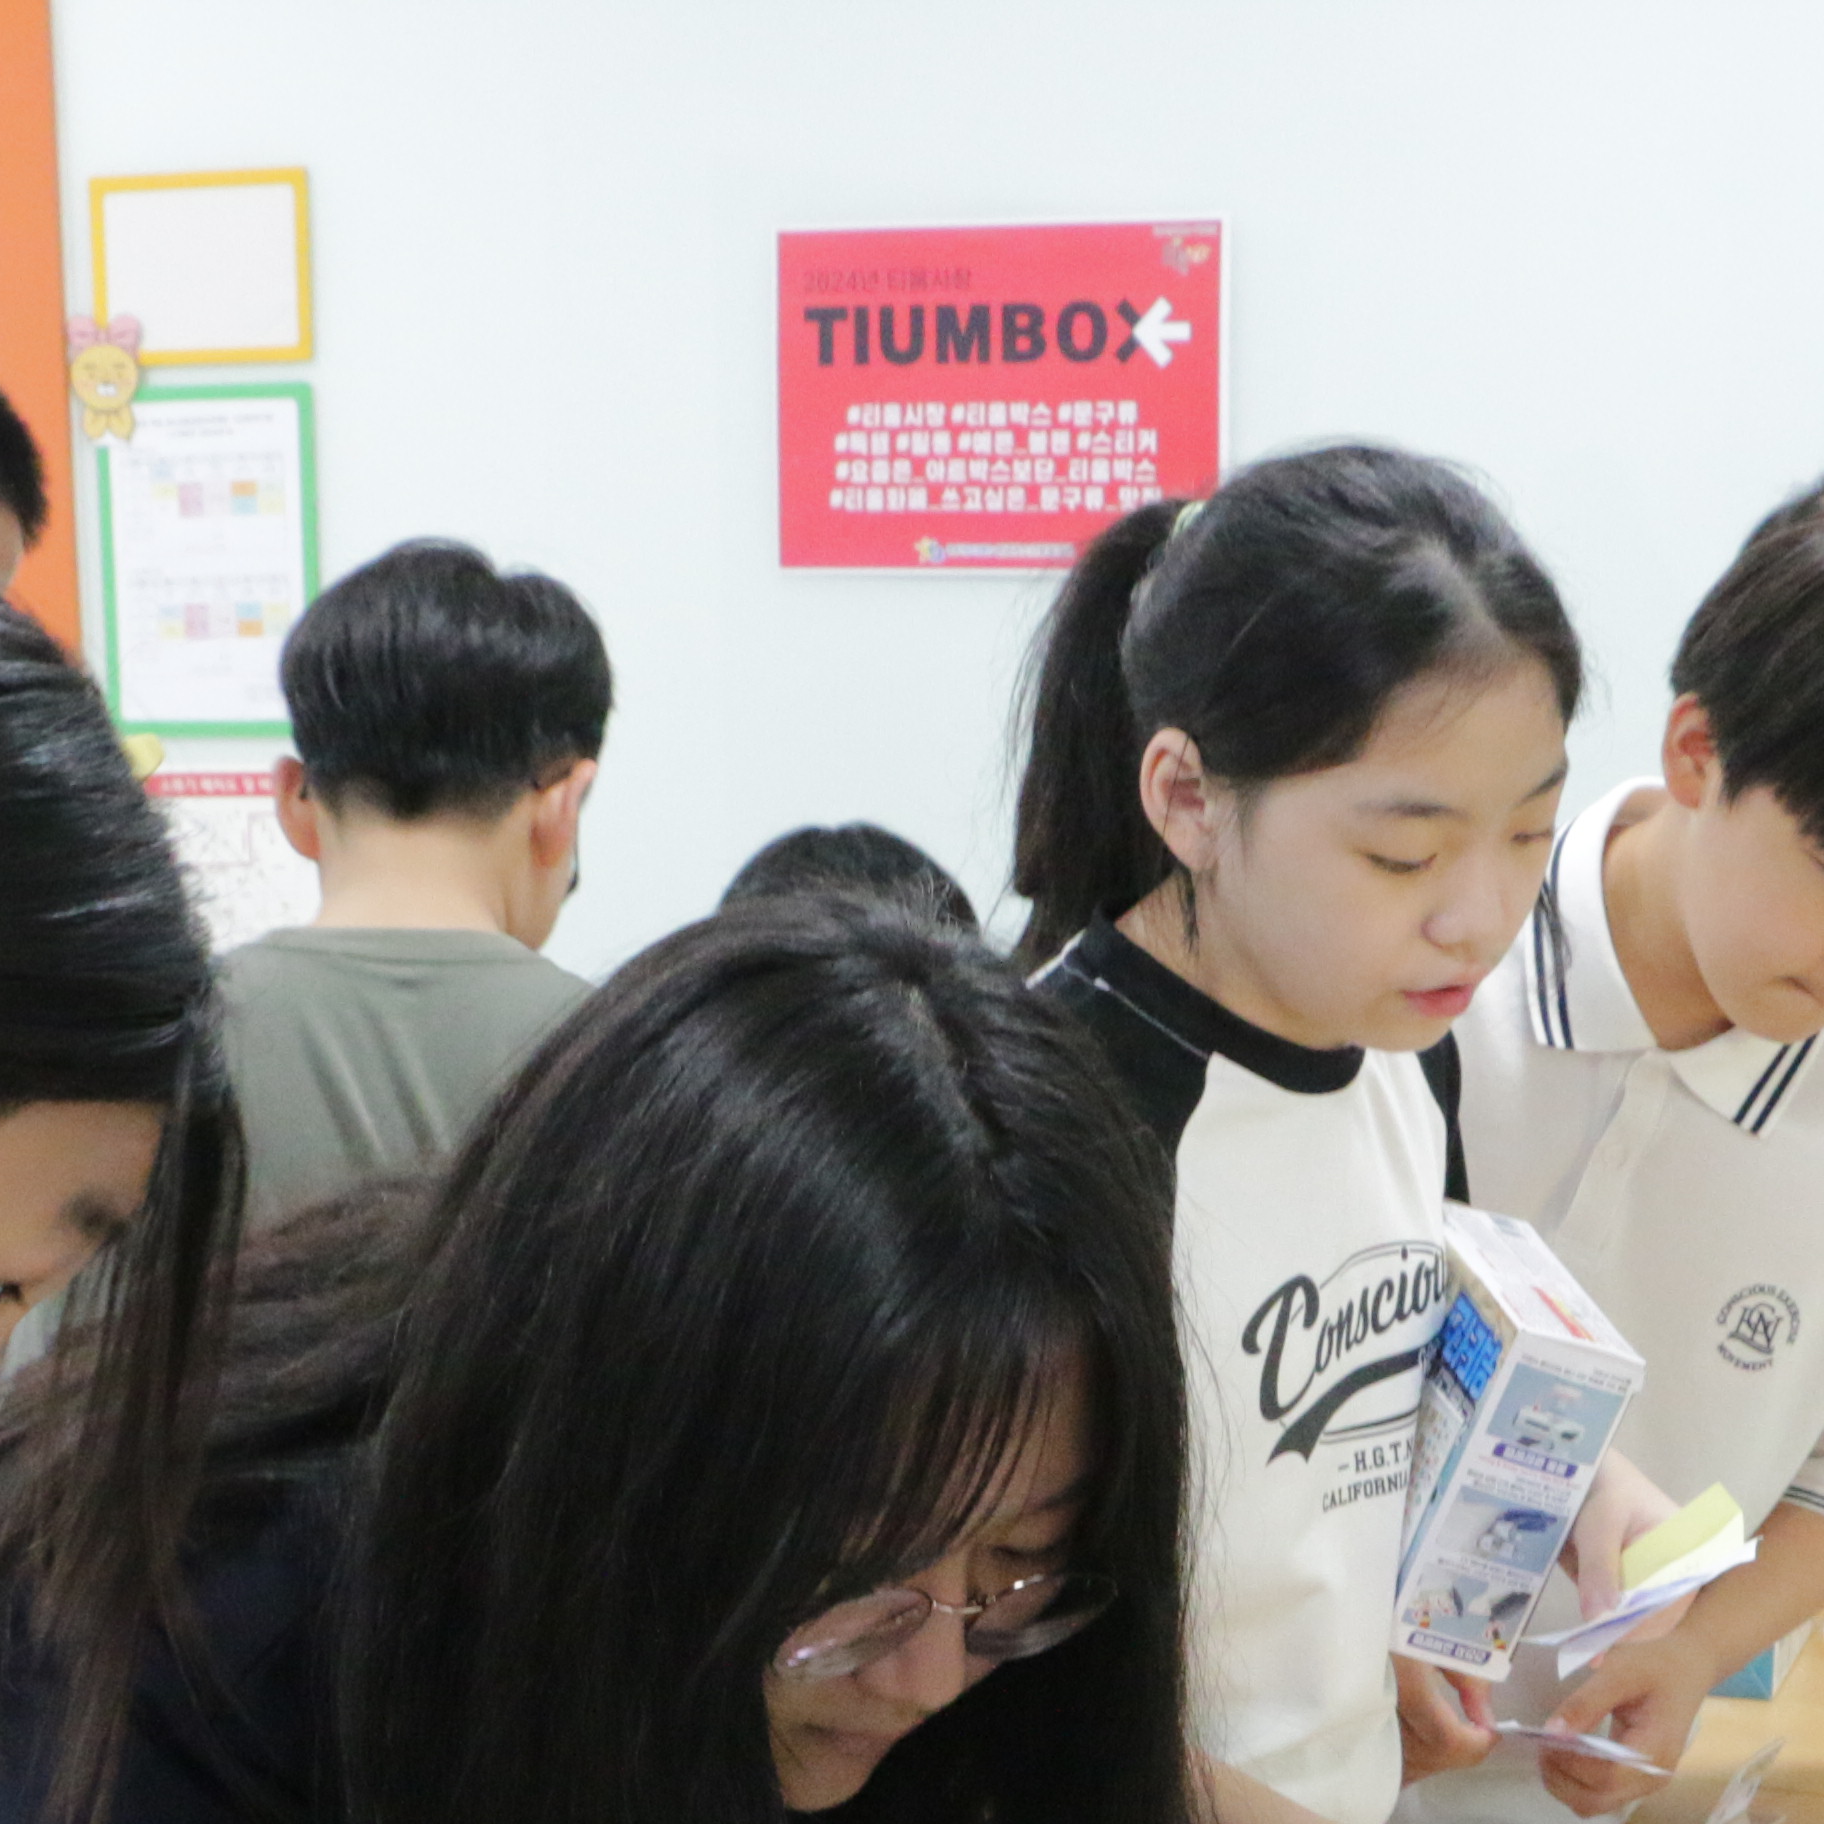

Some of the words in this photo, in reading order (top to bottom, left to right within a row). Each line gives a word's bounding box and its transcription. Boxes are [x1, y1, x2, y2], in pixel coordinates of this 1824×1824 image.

[951, 400, 1052, 428] #티움박스
[1077, 428, 1158, 455] #스티커
[1717, 1282, 1776, 1325] CONSCIOUS
[1717, 1341, 1773, 1371] MOVEMENT
